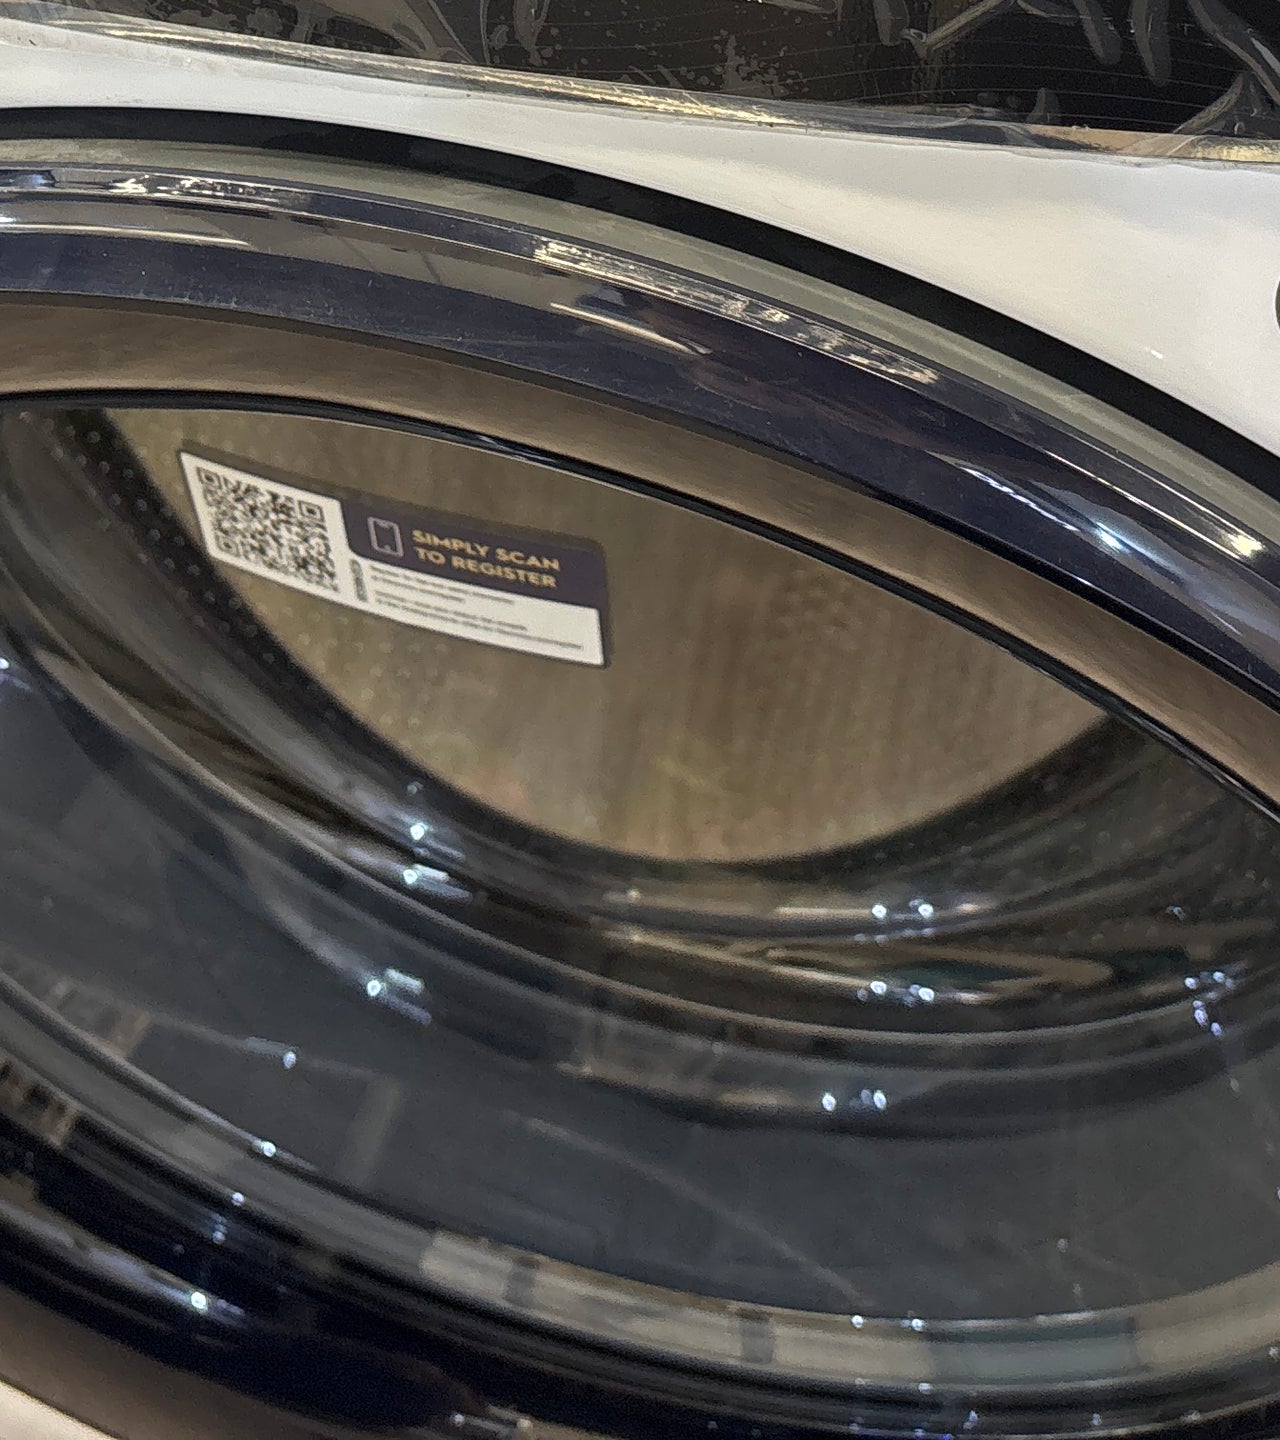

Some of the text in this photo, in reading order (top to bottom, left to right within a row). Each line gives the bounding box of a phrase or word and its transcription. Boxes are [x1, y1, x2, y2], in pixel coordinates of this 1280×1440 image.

[411, 528, 562, 572] SIMPLY SCAN
[415, 547, 447, 566] TO
[450, 557, 558, 589] REGISTER
